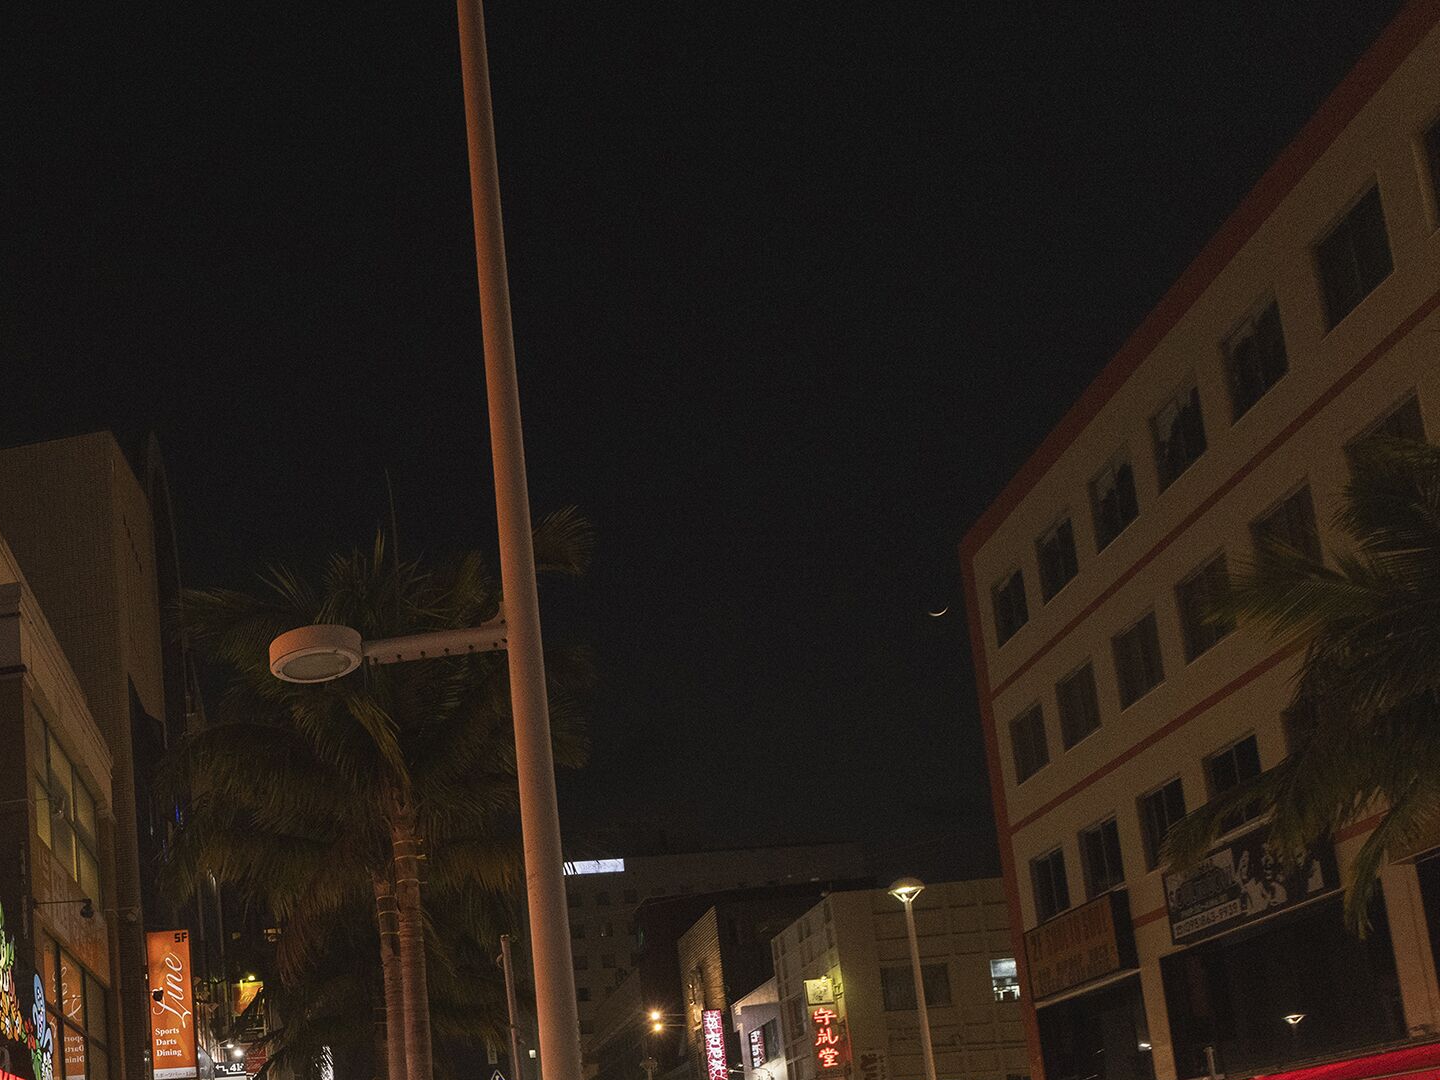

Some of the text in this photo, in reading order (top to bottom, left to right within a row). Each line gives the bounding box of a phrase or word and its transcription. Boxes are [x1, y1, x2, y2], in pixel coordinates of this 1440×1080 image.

[152, 952, 191, 1029] Line
[155, 1028, 180, 1037] Sports
[156, 1038, 177, 1046] Darts
[156, 1048, 183, 1057] Dining
